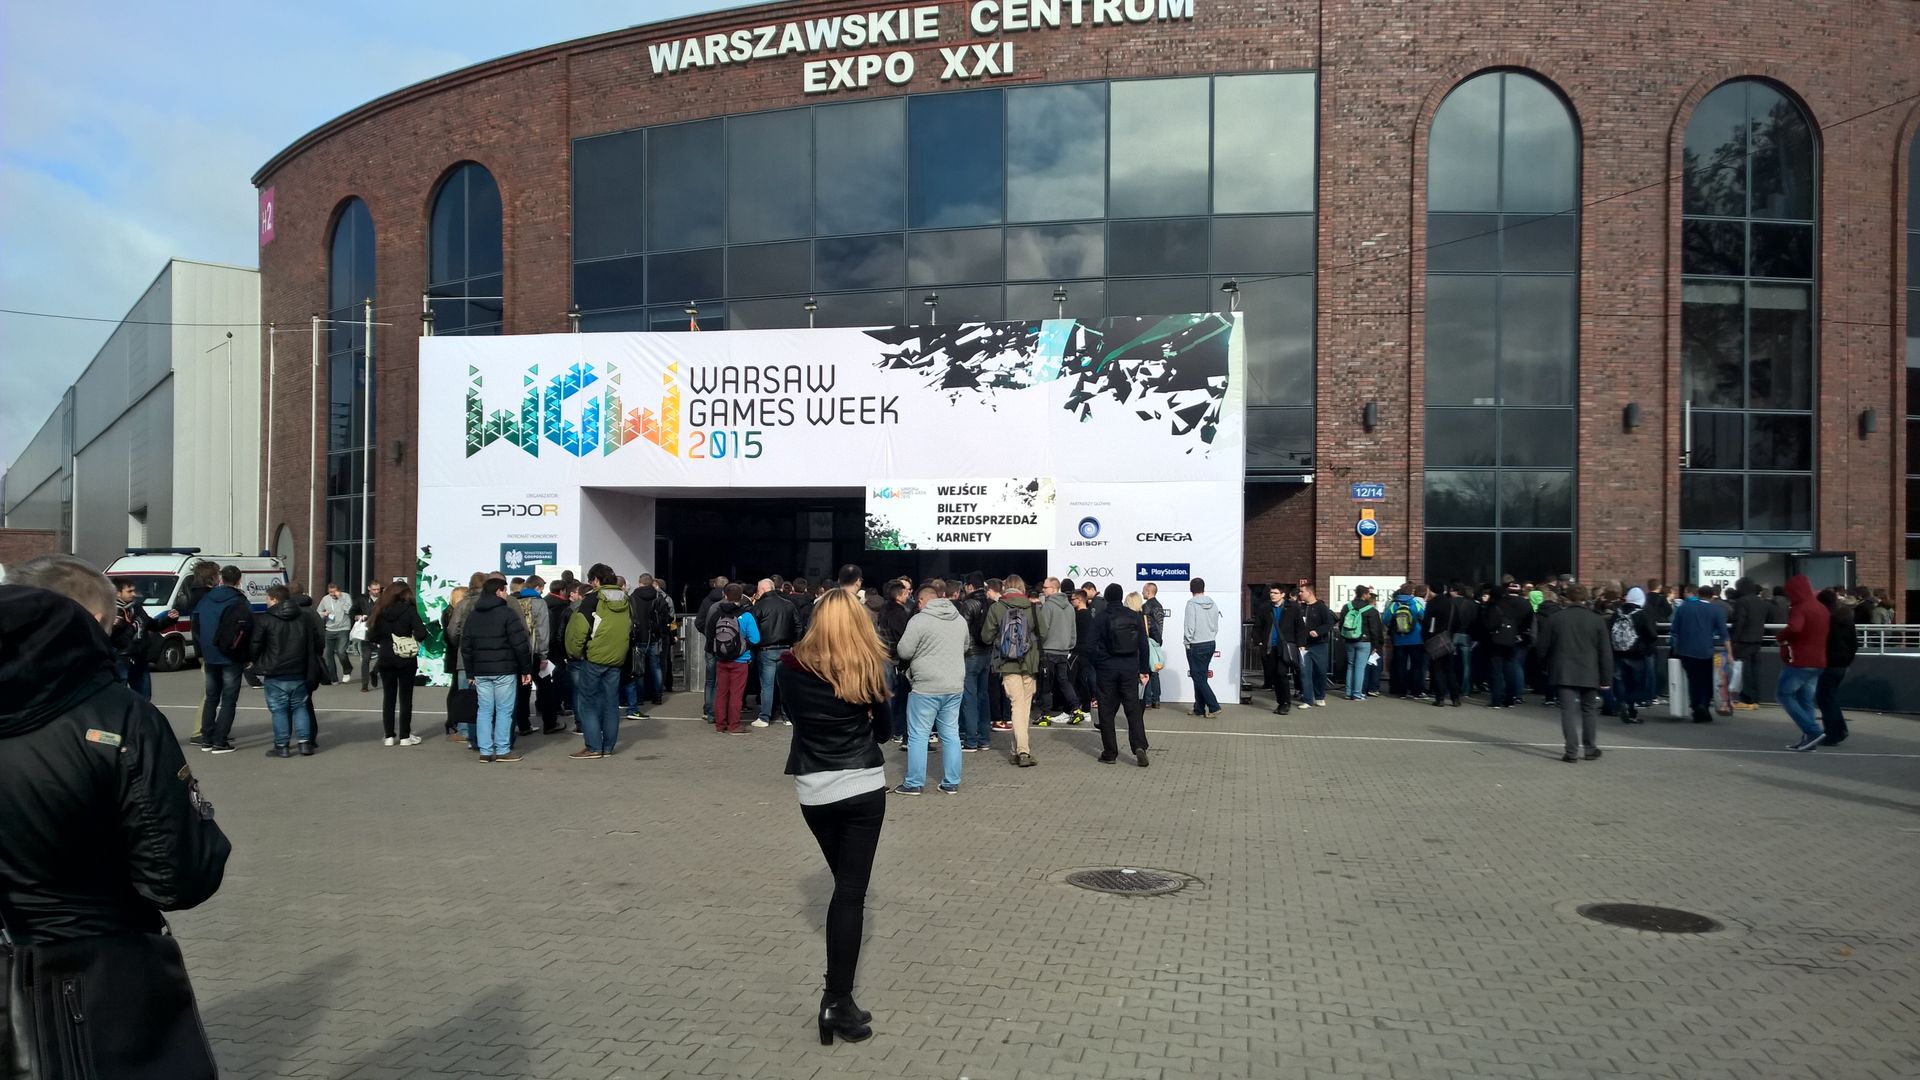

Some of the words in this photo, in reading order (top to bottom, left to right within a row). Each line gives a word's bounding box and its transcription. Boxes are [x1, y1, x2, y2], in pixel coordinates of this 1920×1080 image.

[649, 5, 940, 75] WARSZAWSKIE
[970, 0, 1195, 34] CENTRUM
[803, 51, 915, 94] EXPO
[940, 41, 1014, 80] XXI
[689, 364, 836, 395] WARSAW
[689, 398, 795, 428] GAMES
[806, 395, 900, 426] WEEK
[688, 430, 763, 460] 2015
[937, 483, 988, 496] WEJŚCIE
[1356, 488, 1382, 497] 12/14
[937, 503, 978, 513] BILETY
[937, 512, 1038, 526] PRZEDSPRZEDAŻ
[936, 532, 992, 543] KARNETY
[1136, 532, 1192, 542] CENEGA
[1084, 567, 1114, 577] XBOX
